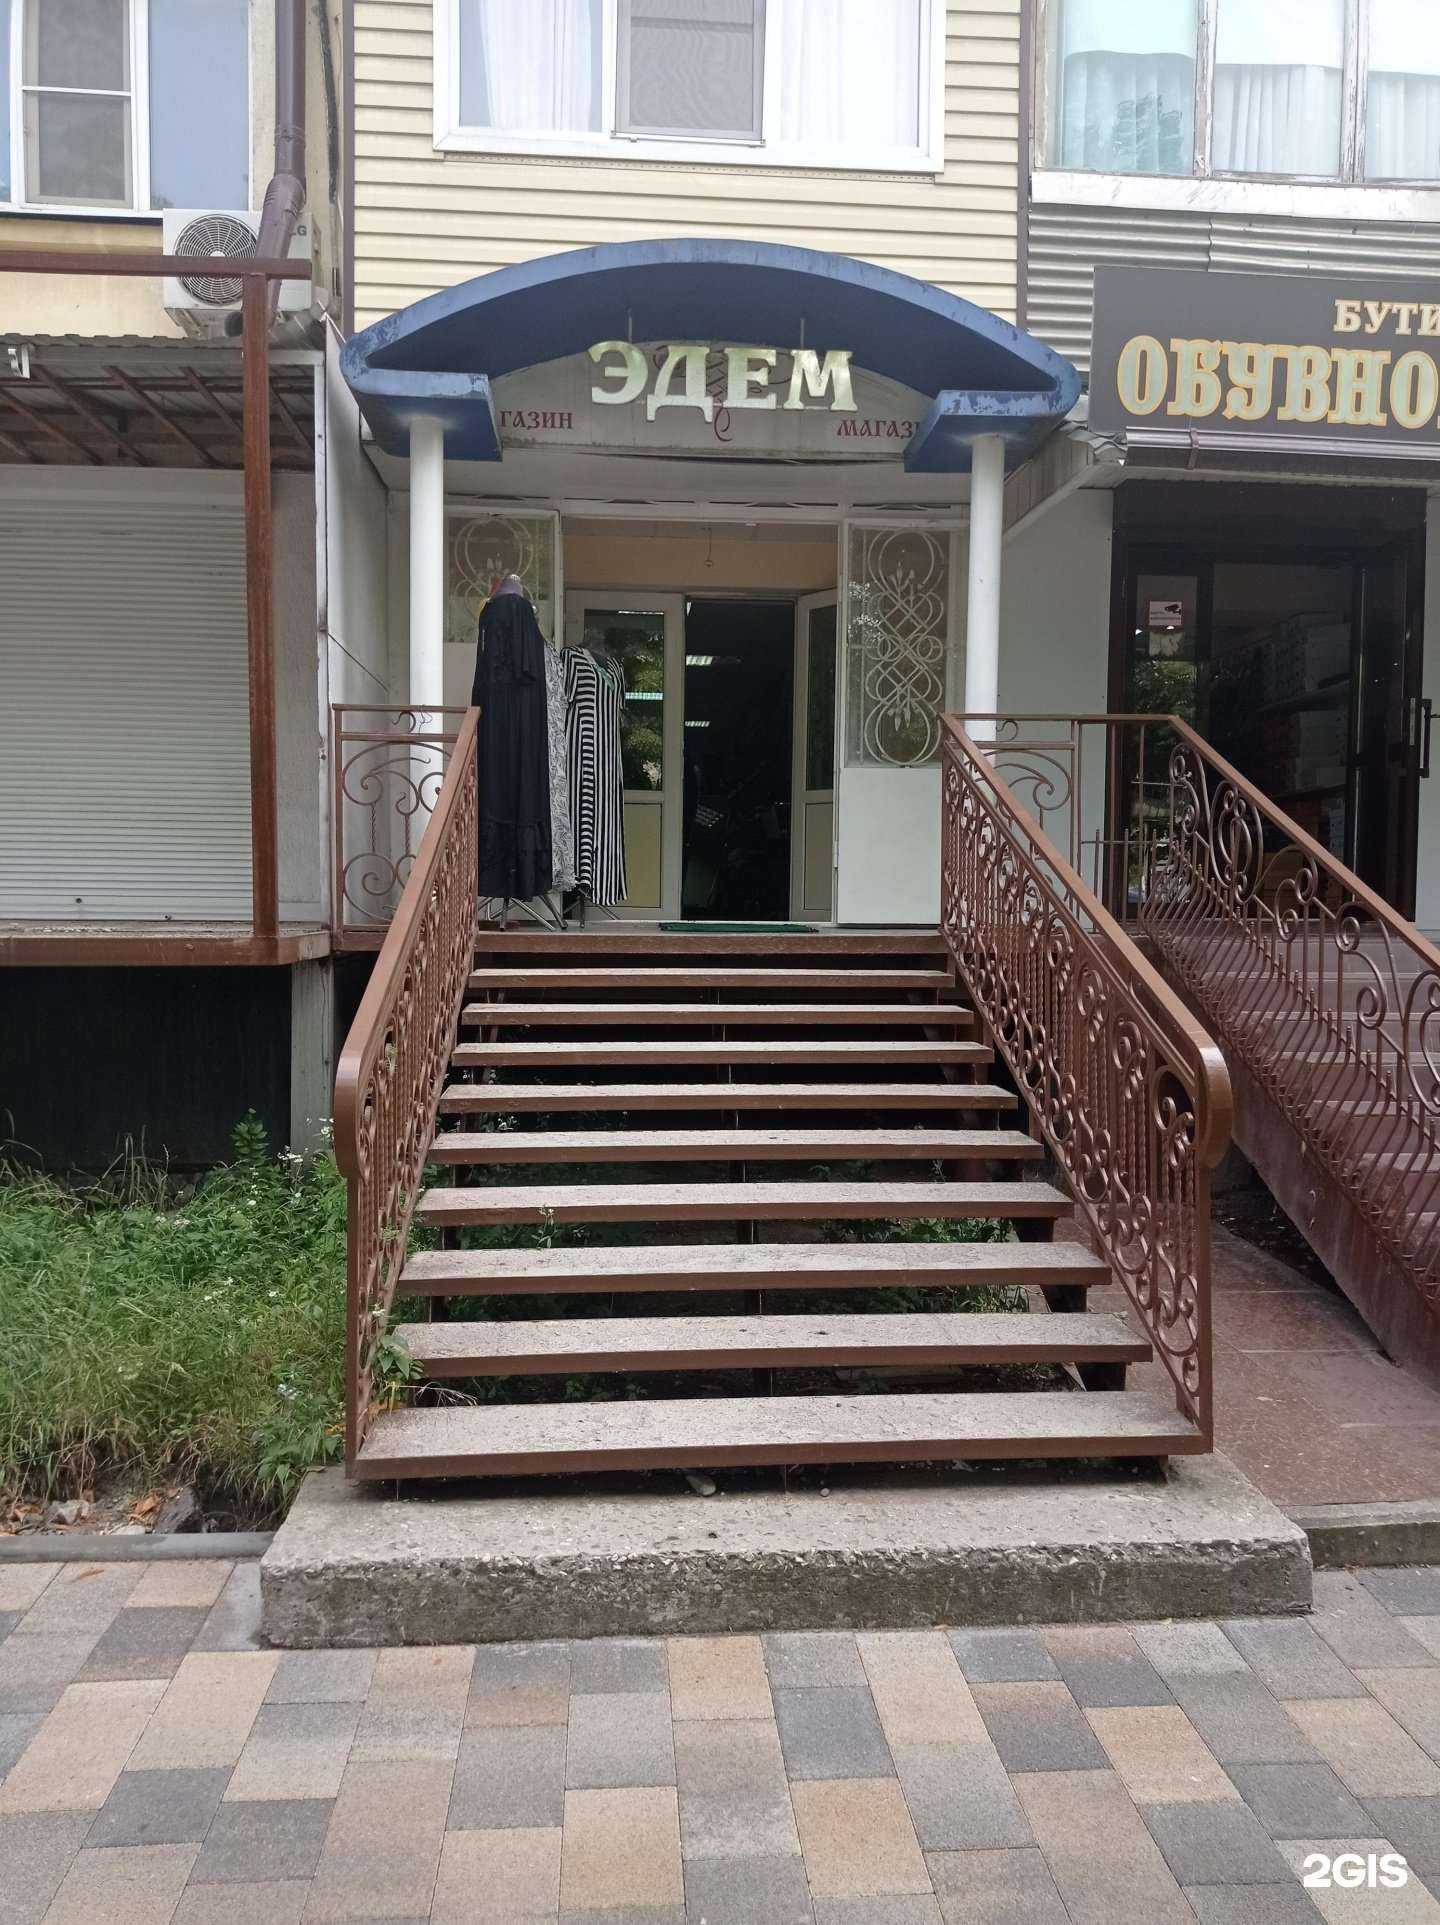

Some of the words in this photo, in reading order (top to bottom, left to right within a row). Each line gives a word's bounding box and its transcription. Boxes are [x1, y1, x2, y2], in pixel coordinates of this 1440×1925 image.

[1333, 299, 1440, 336] БУТИ
[588, 340, 858, 423] ЭДЕМ
[1117, 335, 1440, 430] ОБУВНО
[500, 410, 573, 430] ГАЗИН
